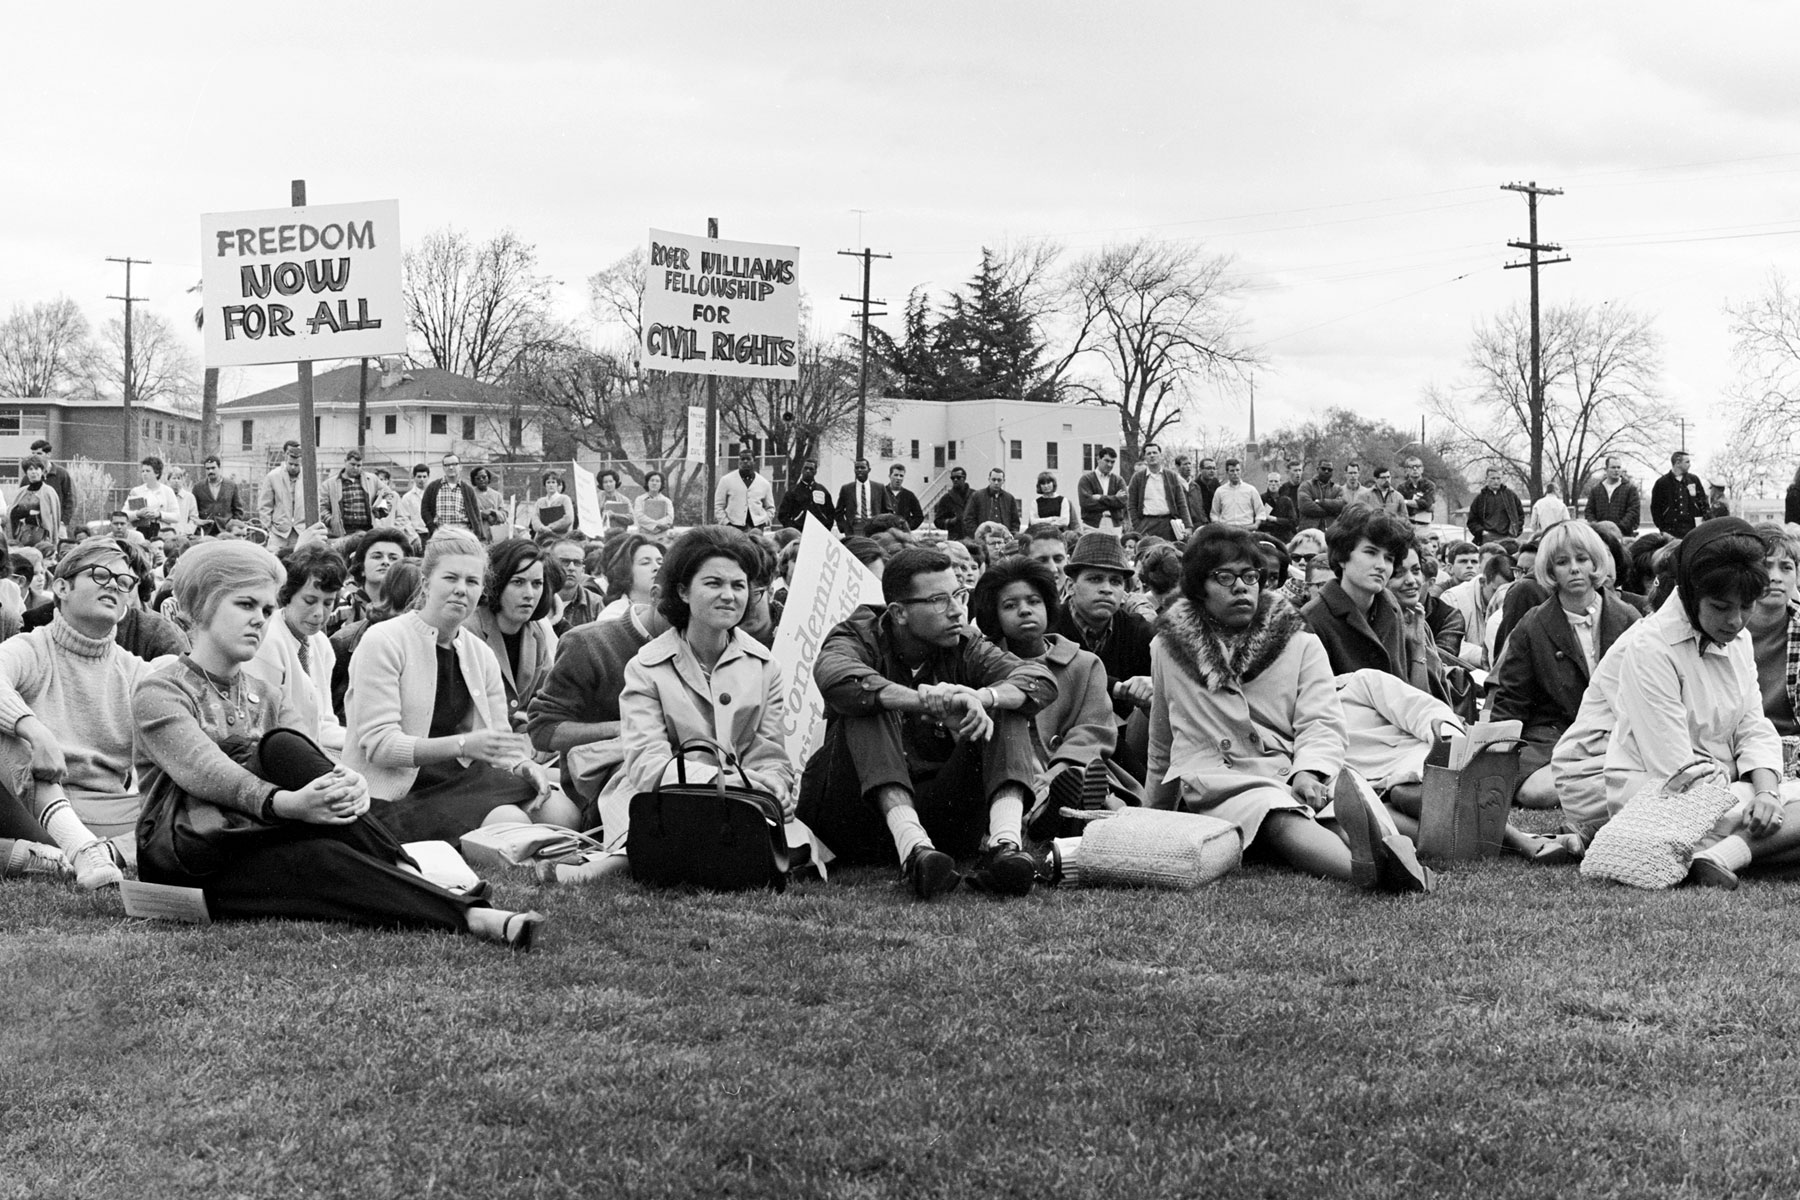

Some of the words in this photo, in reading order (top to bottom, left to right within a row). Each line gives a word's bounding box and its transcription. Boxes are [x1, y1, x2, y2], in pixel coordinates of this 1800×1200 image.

[216, 220, 376, 257] FREEDOM
[240, 257, 350, 299] NOW
[651, 241, 690, 271] ROGER
[701, 251, 795, 285] WILLIAMS
[665, 270, 775, 301] FELLOWSHIP
[222, 303, 296, 341] FOR
[306, 298, 382, 335] ALL
[692, 303, 731, 324] FOR
[647, 322, 706, 363] CIVIL
[711, 331, 797, 367] RIGHTS
